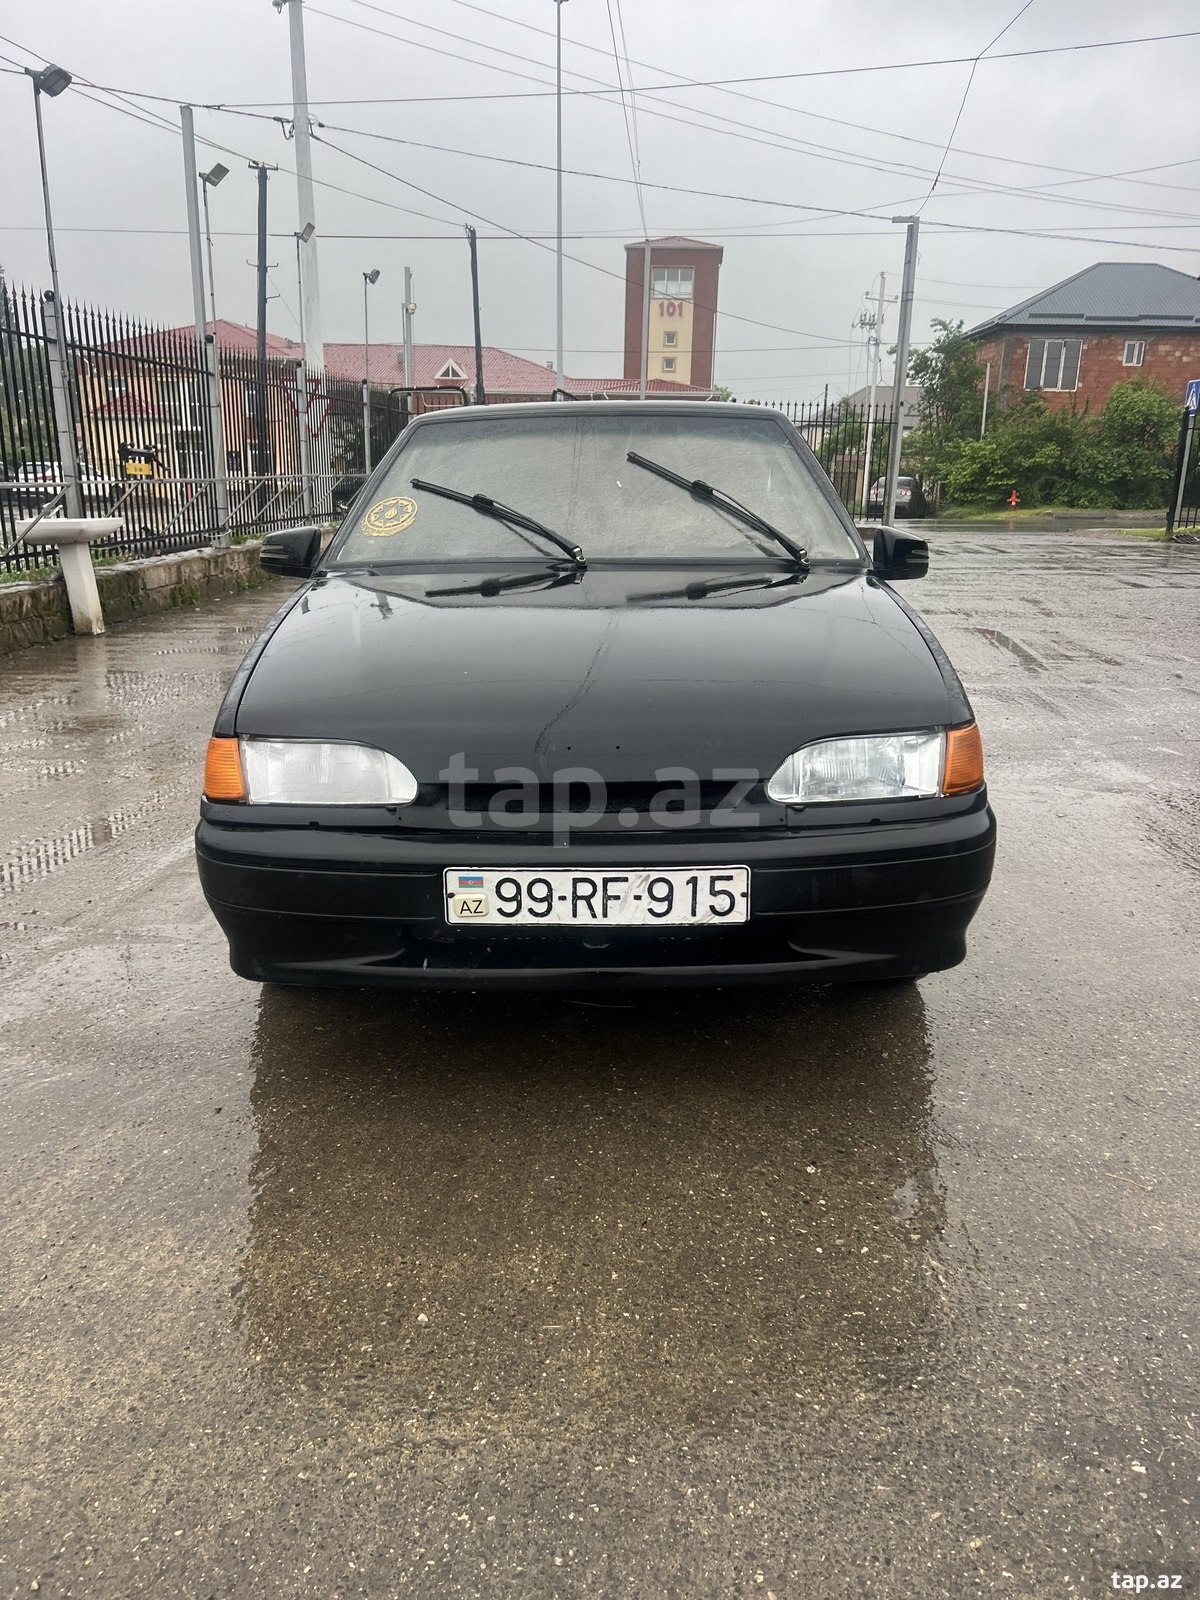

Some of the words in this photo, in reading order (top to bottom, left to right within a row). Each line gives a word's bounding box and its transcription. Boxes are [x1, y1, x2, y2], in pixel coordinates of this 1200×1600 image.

[658, 301, 683, 317] 101
[495, 875, 736, 918] 99-RF-915
[459, 900, 484, 914] AZ
